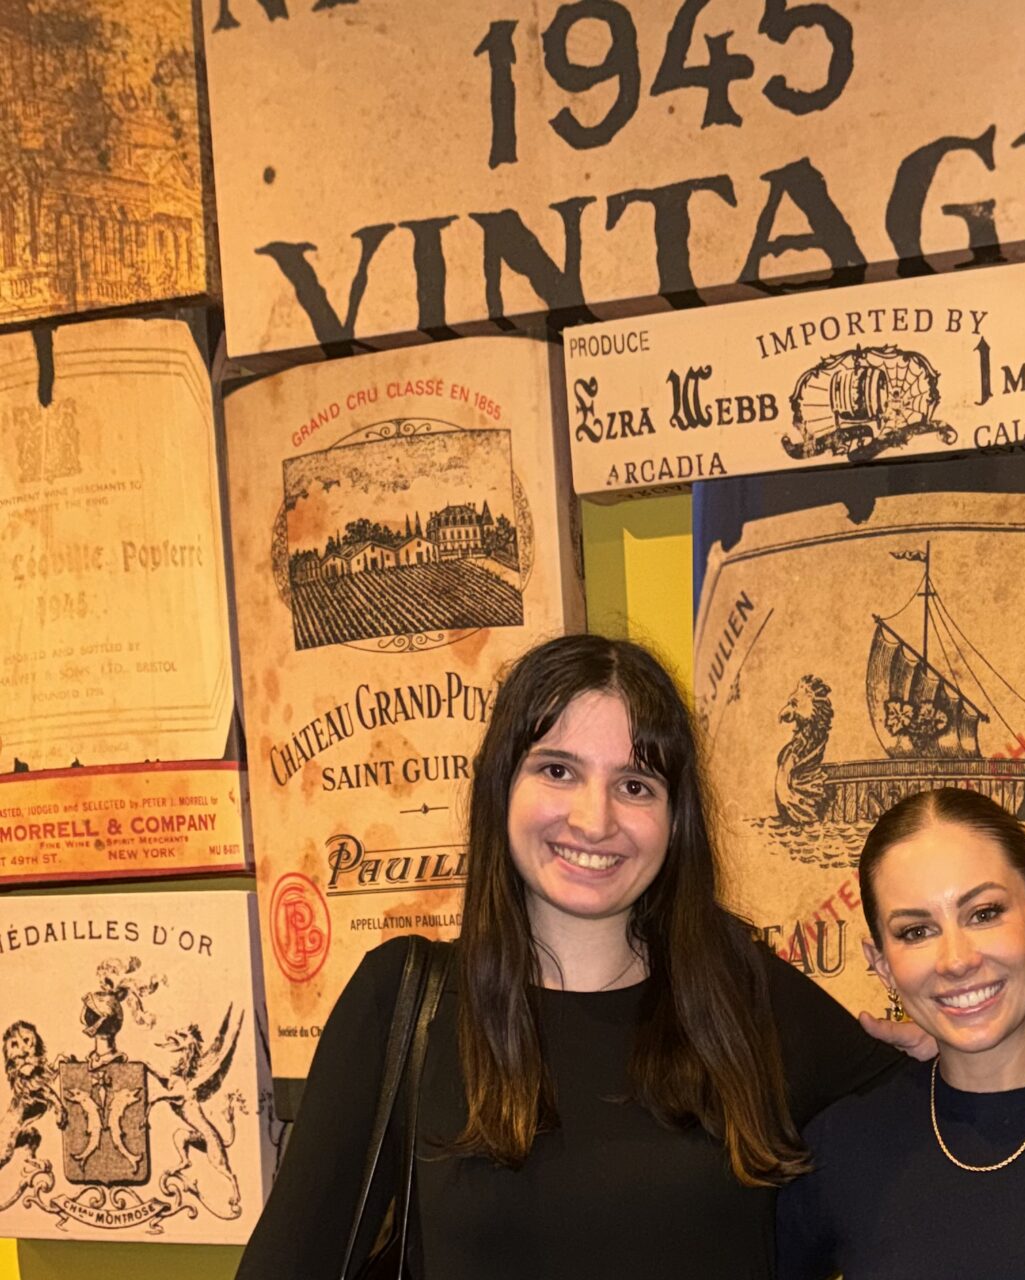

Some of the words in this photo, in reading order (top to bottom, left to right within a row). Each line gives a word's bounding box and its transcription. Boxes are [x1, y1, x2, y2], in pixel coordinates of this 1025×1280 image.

[474, 0, 853, 169] 1945
[569, 330, 650, 358] PRODUCE
[756, 309, 933, 359] IMPORTED
[945, 309, 988, 334] BY
[291, 402, 341, 448] GRAND
[346, 387, 378, 411] CRU
[386, 378, 444, 399] CLASSÉ
[450, 384, 470, 402] EN
[473, 392, 502, 421] 1855
[606, 452, 728, 486] ARCADIA
[708, 590, 755, 701] JULIEN
[322, 760, 395, 792] SAINT
[402, 755, 471, 783] GUIR
[83, 798, 126, 812] SELECTED
[142, 797, 167, 808] PETER
[0, 819, 99, 842] MORRELL
[107, 818, 122, 836] &
[130, 813, 217, 835] COMPANY
[108, 849, 138, 861] NEW
[141, 847, 176, 859] YORK
[325, 833, 469, 889] PAUILL
[350, 916, 412, 931] APPELLATION
[153, 925, 214, 956] D'OR
[94, 1205, 156, 1224] MONTROSE
